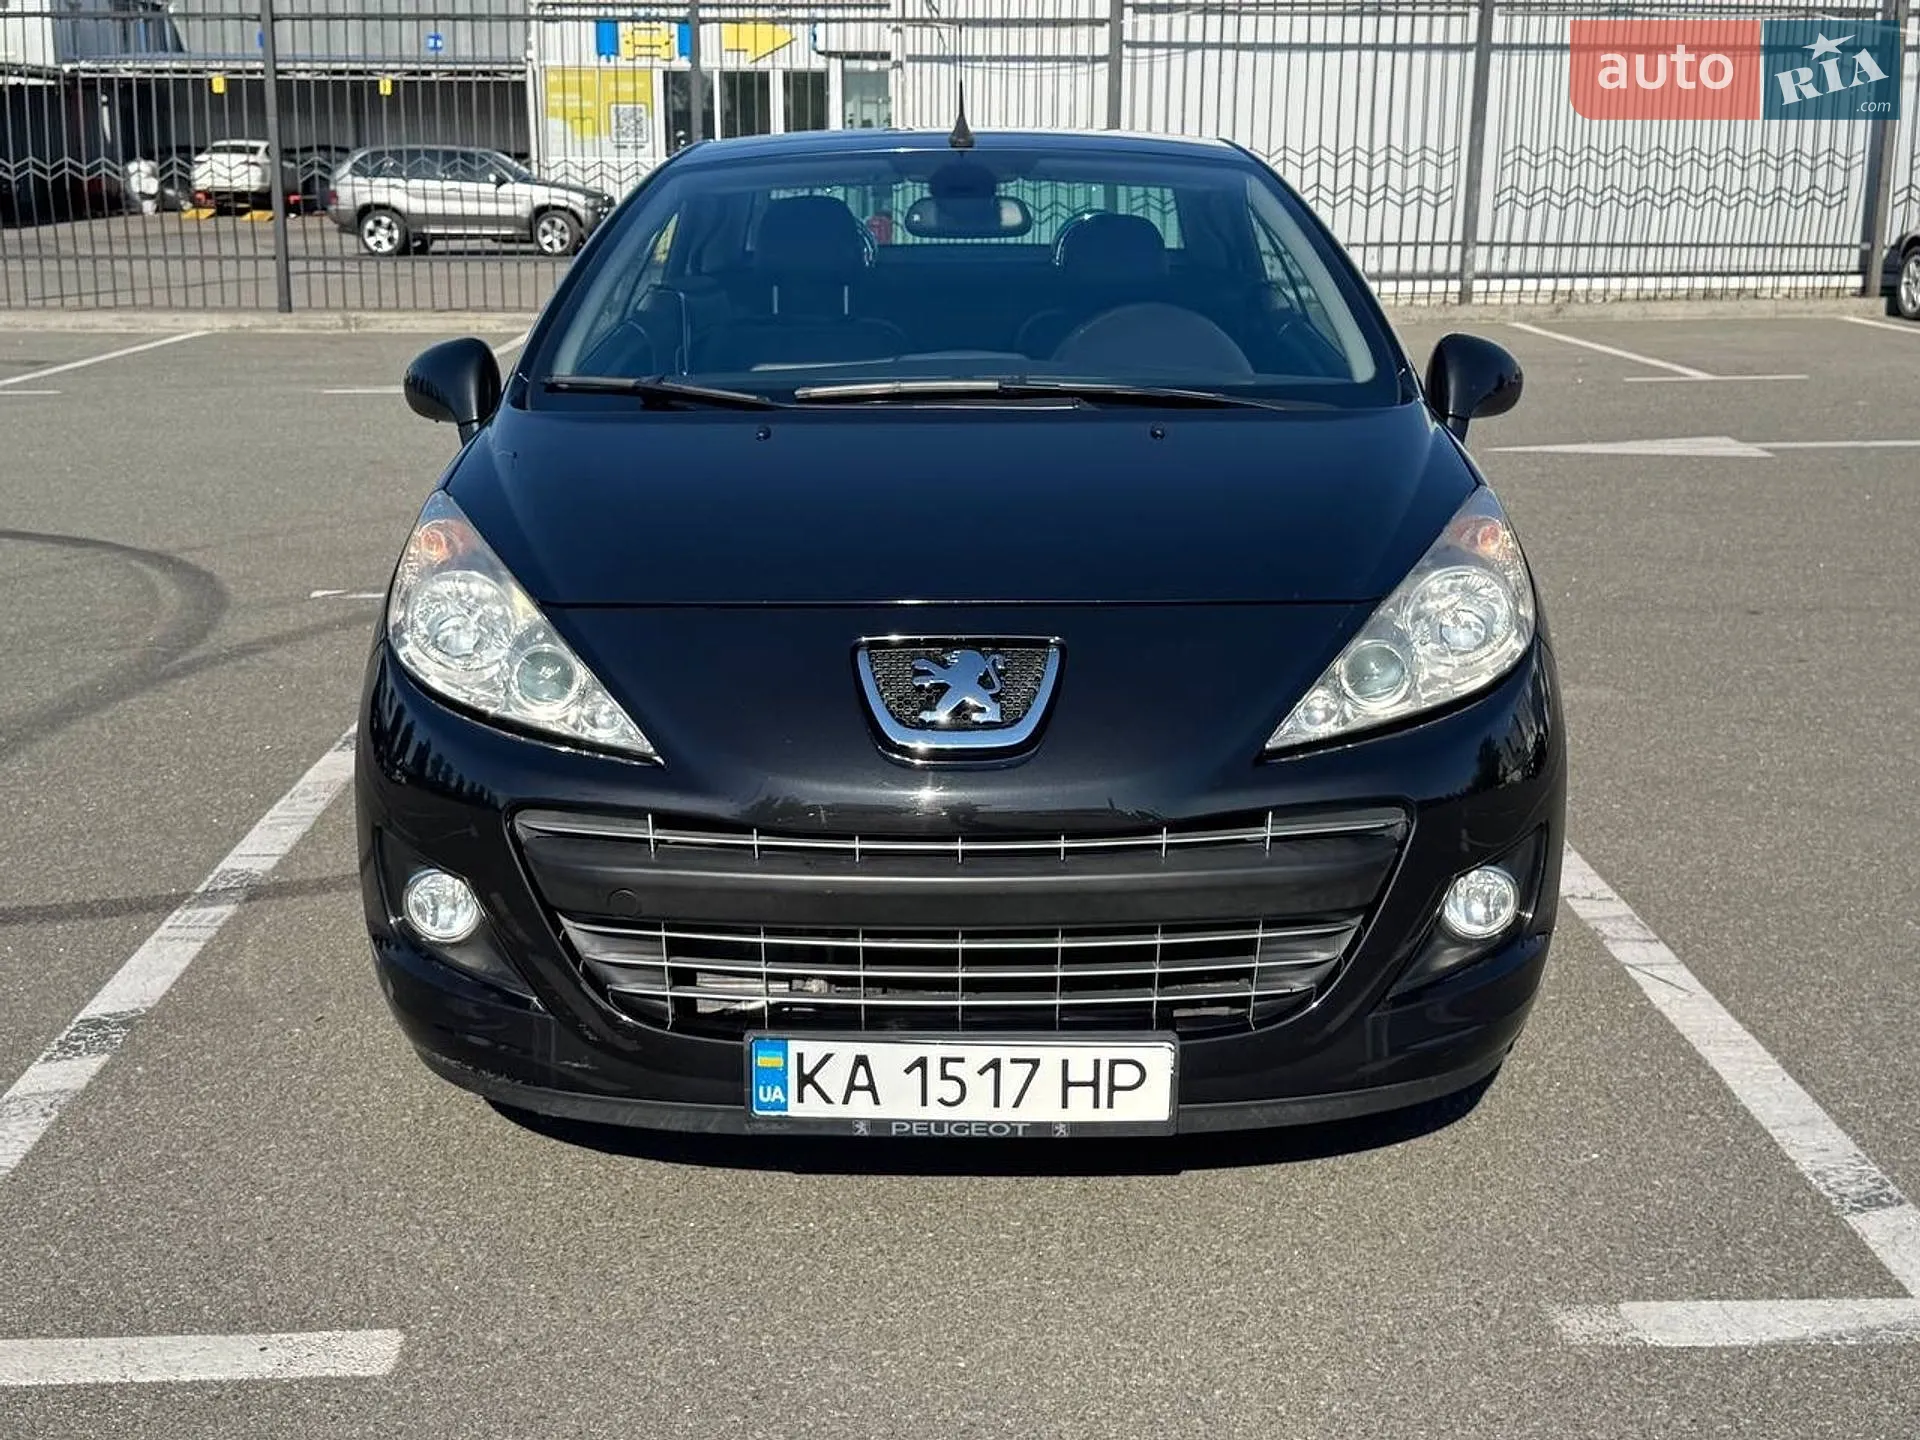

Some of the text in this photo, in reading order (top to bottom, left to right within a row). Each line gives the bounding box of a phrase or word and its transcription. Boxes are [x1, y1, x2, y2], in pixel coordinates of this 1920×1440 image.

[796, 1051, 1148, 1110] KA 1517 HP
[758, 1084, 786, 1103] UA
[890, 1121, 1031, 1138] PEUGEOT
